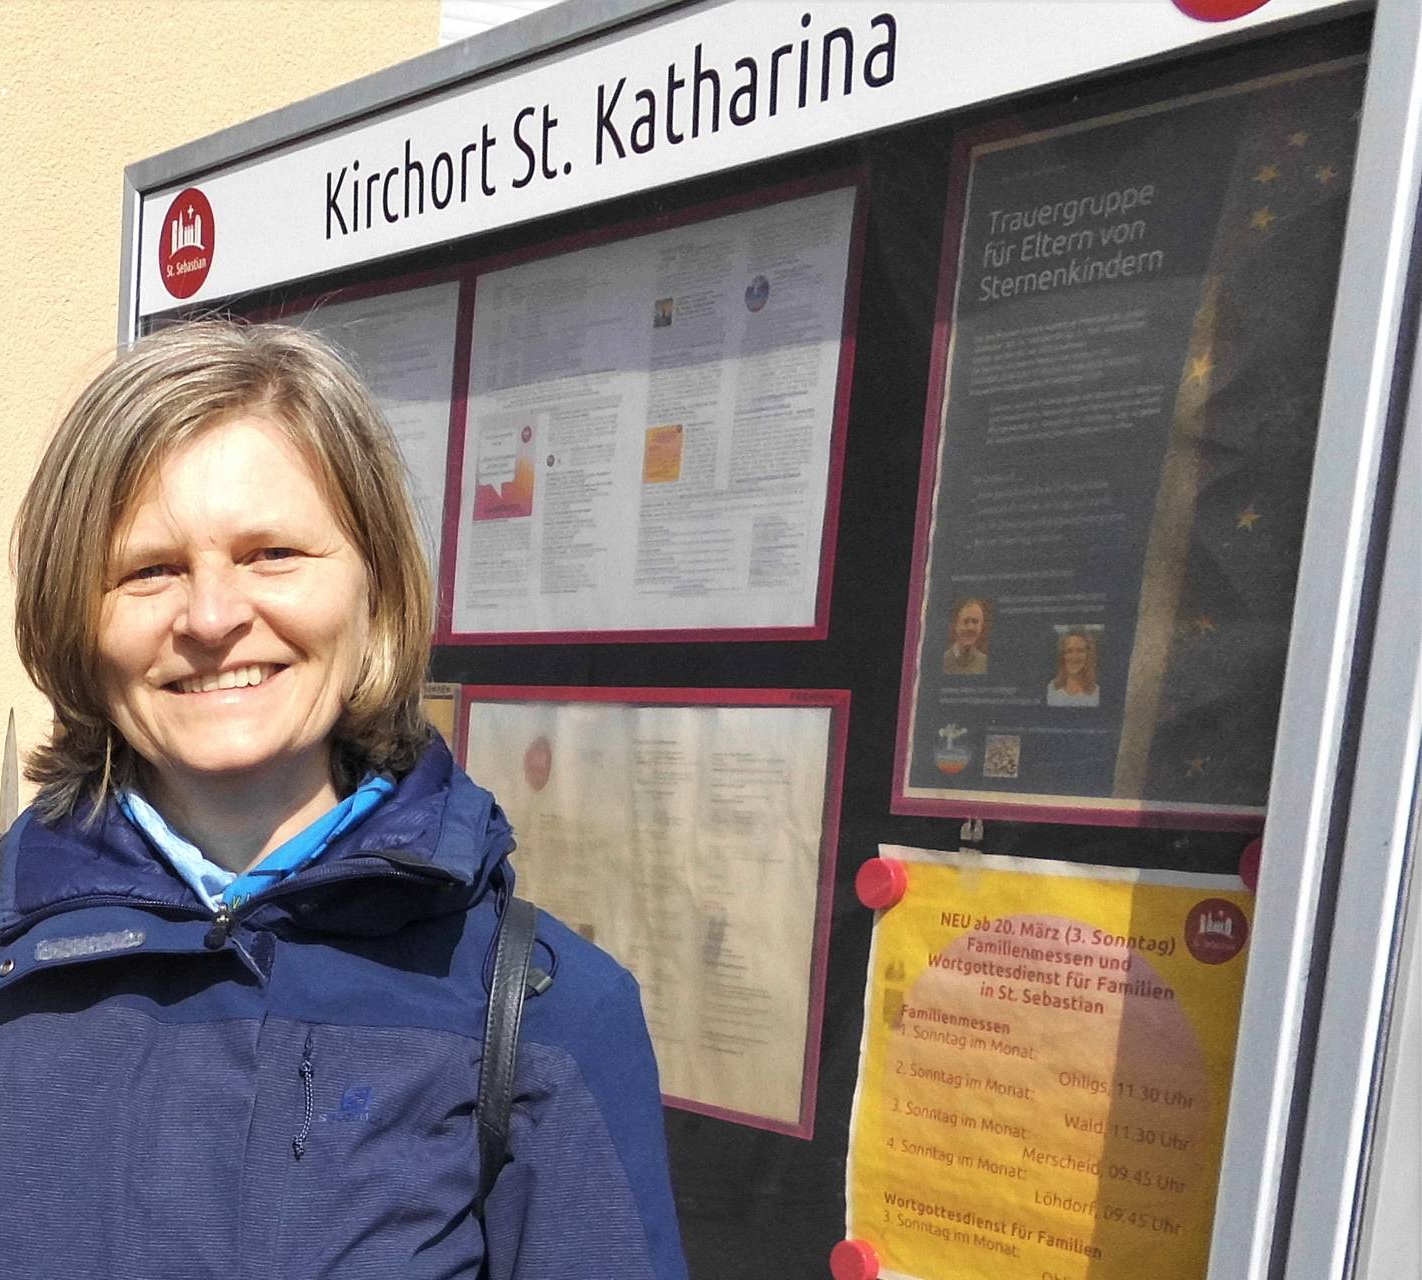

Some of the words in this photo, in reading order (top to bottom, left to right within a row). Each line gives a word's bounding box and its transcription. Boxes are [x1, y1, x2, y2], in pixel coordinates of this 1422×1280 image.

[326, 124, 497, 240] Kirchort
[512, 103, 572, 190] St.
[596, 12, 898, 166] Katharina
[990, 184, 1155, 235] Trauergruppe
[983, 240, 1018, 269] für
[1020, 230, 1094, 262] Eltern
[1100, 219, 1147, 246] von
[166, 264, 175, 278] St.
[176, 257, 207, 275] Sebastian
[979, 250, 1164, 302] Sternenkindern
[940, 911, 971, 930] NEU
[974, 916, 991, 933] ab
[994, 918, 1016, 937] 20.
[1020, 922, 1060, 941] März
[1065, 925, 1086, 945] (3.
[1091, 929, 1176, 957] Sonntag)
[967, 937, 1095, 968] Familienmessen
[1099, 954, 1131, 973] und
[928, 953, 1060, 987] Wortgottesdienst
[1066, 972, 1091, 990] für
[1096, 979, 1175, 1000] Familien
[980, 981, 995, 998] in
[998, 985, 1018, 1002] St.
[1022, 989, 1105, 1014] Sebastian
[901, 1004, 1011, 1035] Familienmessen
[913, 1025, 967, 1050] Sonntag
[970, 1036, 987, 1050] im
[991, 1039, 1037, 1061] Monat:
[896, 1060, 907, 1075] 2.
[910, 1062, 963, 1089] Sonntag
[965, 1073, 982, 1089] im
[985, 1077, 1035, 1101] Monat:
[1164, 1090, 1193, 1109] Uhr
[905, 1101, 958, 1128] Sonntag
[961, 1113, 977, 1129] im
[981, 1117, 1031, 1140] Monat:
[886, 1136, 897, 1151] 4.
[901, 1139, 954, 1167] Sonntag
[958, 1153, 974, 1168] im
[978, 1158, 1028, 1180] Monat:
[1161, 1130, 1189, 1151] Uhr
[1109, 1164, 1152, 1187] 09.45
[1157, 1174, 1187, 1194] Uhr
[883, 1210, 894, 1225] 3.
[897, 1213, 950, 1241] Sonntag
[954, 1231, 970, 1245] im
[884, 1191, 1007, 1234] Wortgottesdienst
[1011, 1222, 1033, 1241] für
[1037, 1230, 1103, 1259] Familien
[1103, 1204, 1147, 1228] 09.45
[1152, 1215, 1180, 1235] Uhr
